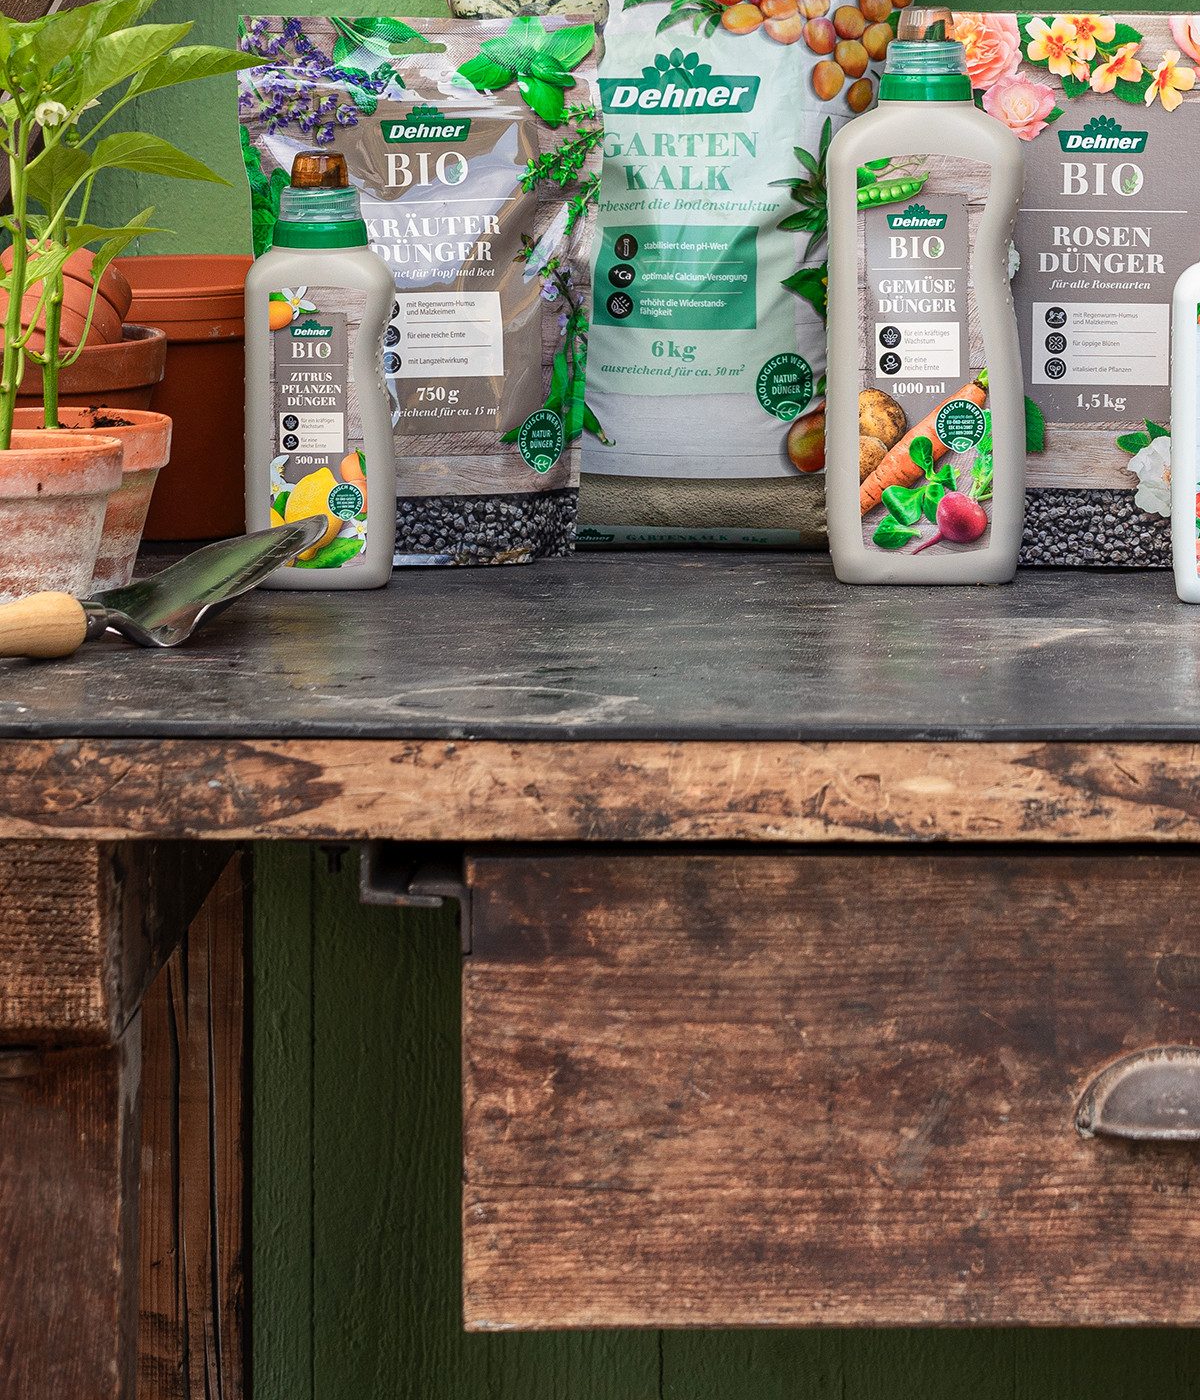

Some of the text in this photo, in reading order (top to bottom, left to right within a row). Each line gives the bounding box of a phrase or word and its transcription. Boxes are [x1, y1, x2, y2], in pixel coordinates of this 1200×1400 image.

[610, 84, 749, 109] Dehner
[389, 123, 465, 139] Dehner
[603, 131, 759, 159] GARTEN
[1066, 134, 1142, 150] Dehner
[384, 152, 469, 188] BIO
[622, 165, 732, 191] KALK
[1060, 162, 1144, 196] BIO
[598, 198, 780, 214] rbessert die Bodenstruktur
[364, 213, 501, 238] KRÄUTER
[892, 217, 944, 227] Dehner
[1052, 226, 1152, 247] ROSEN
[644, 242, 728, 252] stabilisiert den pH-Wert
[888, 236, 945, 259] BIO
[1038, 247, 1166, 274] DÜNGER
[393, 268, 495, 280] net für Topf und Beet
[642, 273, 748, 282] optimale Calcium-Versorgung
[878, 276, 956, 294] GEMÜSE
[1049, 279, 1151, 290] für alle Rosenarten
[418, 300, 475, 309] Regenwurm-Humus
[666, 299, 678, 307] die
[679, 299, 727, 308] Widerstands-
[878, 295, 957, 313] DÜNGER
[640, 307, 672, 317] fähigkeit
[293, 328, 330, 336] Dehner
[924, 329, 950, 338] kräftiges
[904, 337, 936, 345] Wachstum
[291, 342, 331, 359] BIO
[651, 341, 697, 362] 6 kg
[420, 357, 468, 365] Langzeitwirkung
[290, 372, 332, 382] ZITRUS
[601, 364, 671, 376] ausreichend
[671, 367, 693, 378] für
[715, 367, 727, 376] 50
[759, 356, 811, 407] ÖKOLOGISCH WERTVOLL
[774, 374, 799, 383] NATUR-
[281, 385, 342, 394] PFLANZEN
[772, 384, 800, 395] DÜNGER
[892, 382, 945, 394] 1000 ml
[287, 395, 336, 406] DÜNGER
[416, 387, 459, 403] 750 g
[1077, 394, 1127, 411] 1,5 kg
[437, 407, 456, 418] für
[475, 406, 484, 415] 15
[966, 403, 983, 438] WERTVOLL
[532, 430, 552, 438] NATUR-
[546, 413, 561, 451] WERTVOLL
[530, 439, 553, 448] DÜNGER
[295, 455, 329, 465] 500 ml
